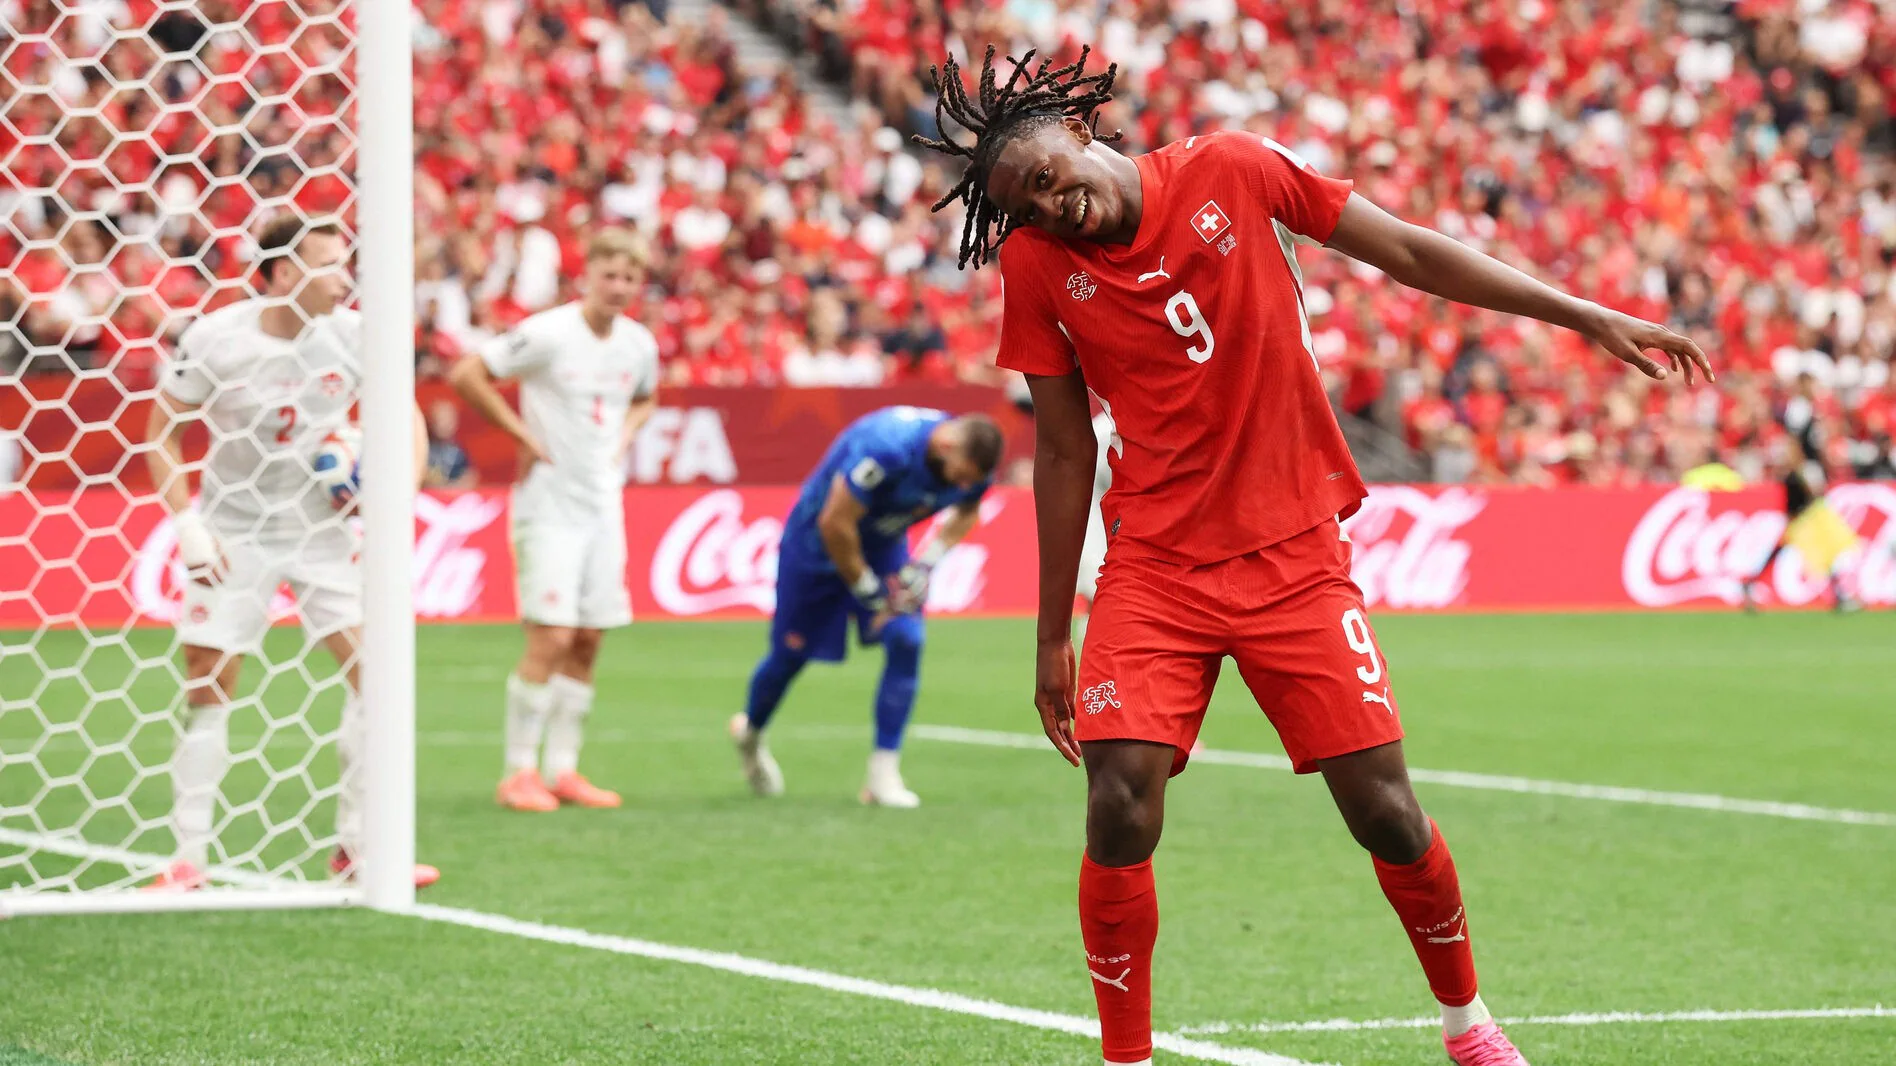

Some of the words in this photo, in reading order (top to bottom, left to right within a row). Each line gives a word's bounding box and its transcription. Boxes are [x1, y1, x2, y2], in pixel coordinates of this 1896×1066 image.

[1163, 286, 1216, 365] 9
[274, 404, 298, 445] 2
[635, 405, 739, 485] FA
[1341, 607, 1382, 685] 9
[1085, 950, 1131, 964] uisse
